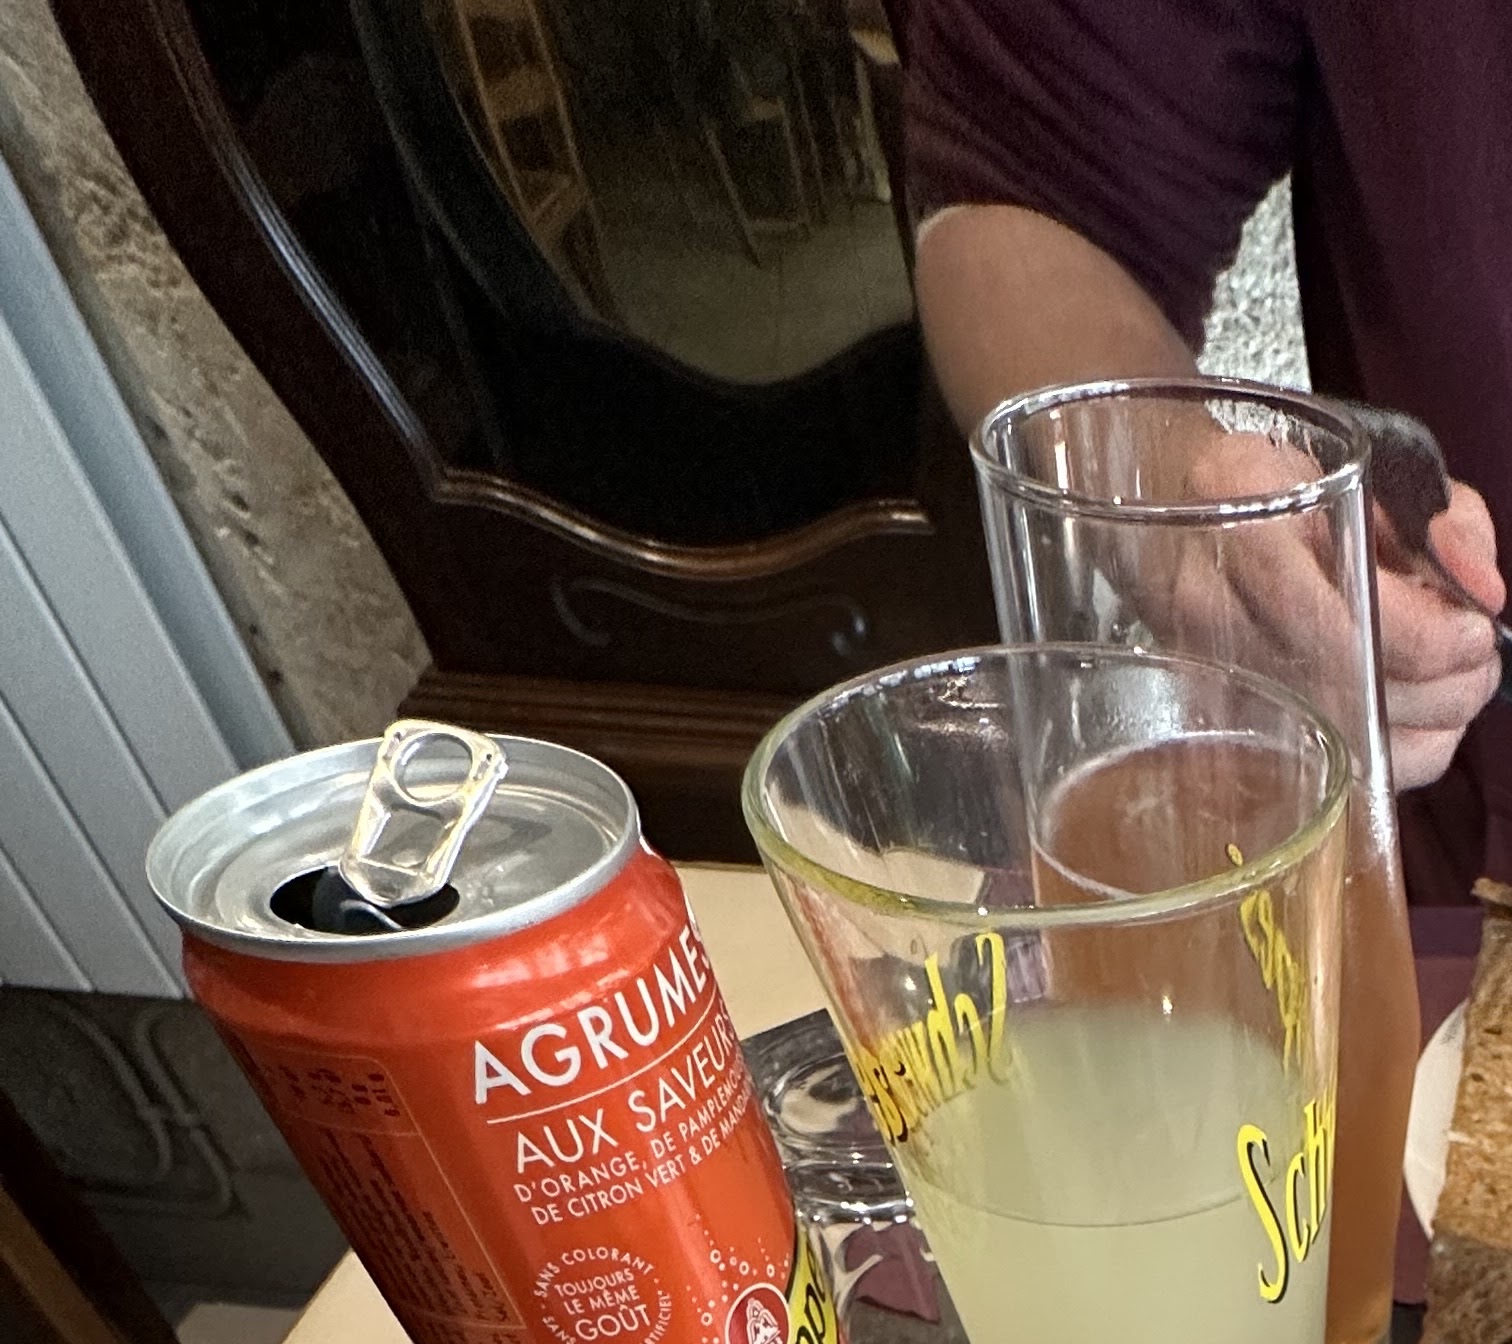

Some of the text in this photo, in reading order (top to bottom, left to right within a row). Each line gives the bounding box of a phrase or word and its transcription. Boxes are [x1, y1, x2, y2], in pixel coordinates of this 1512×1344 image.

[513, 1151, 648, 1203] D'ORANGE,
[650, 1131, 676, 1160] DE
[517, 1108, 619, 1174] AUX
[531, 1203, 563, 1226] DE
[567, 1179, 644, 1218] CITRON
[645, 1154, 686, 1188] VERT
[689, 1145, 703, 1166] &
[701, 1127, 721, 1156] DE
[533, 1246, 655, 1298] SANS COLORANT
[554, 1268, 635, 1297] TOUJOURS
[563, 1284, 640, 1315] LE MÊME
[575, 1303, 651, 1341] GOÛT
